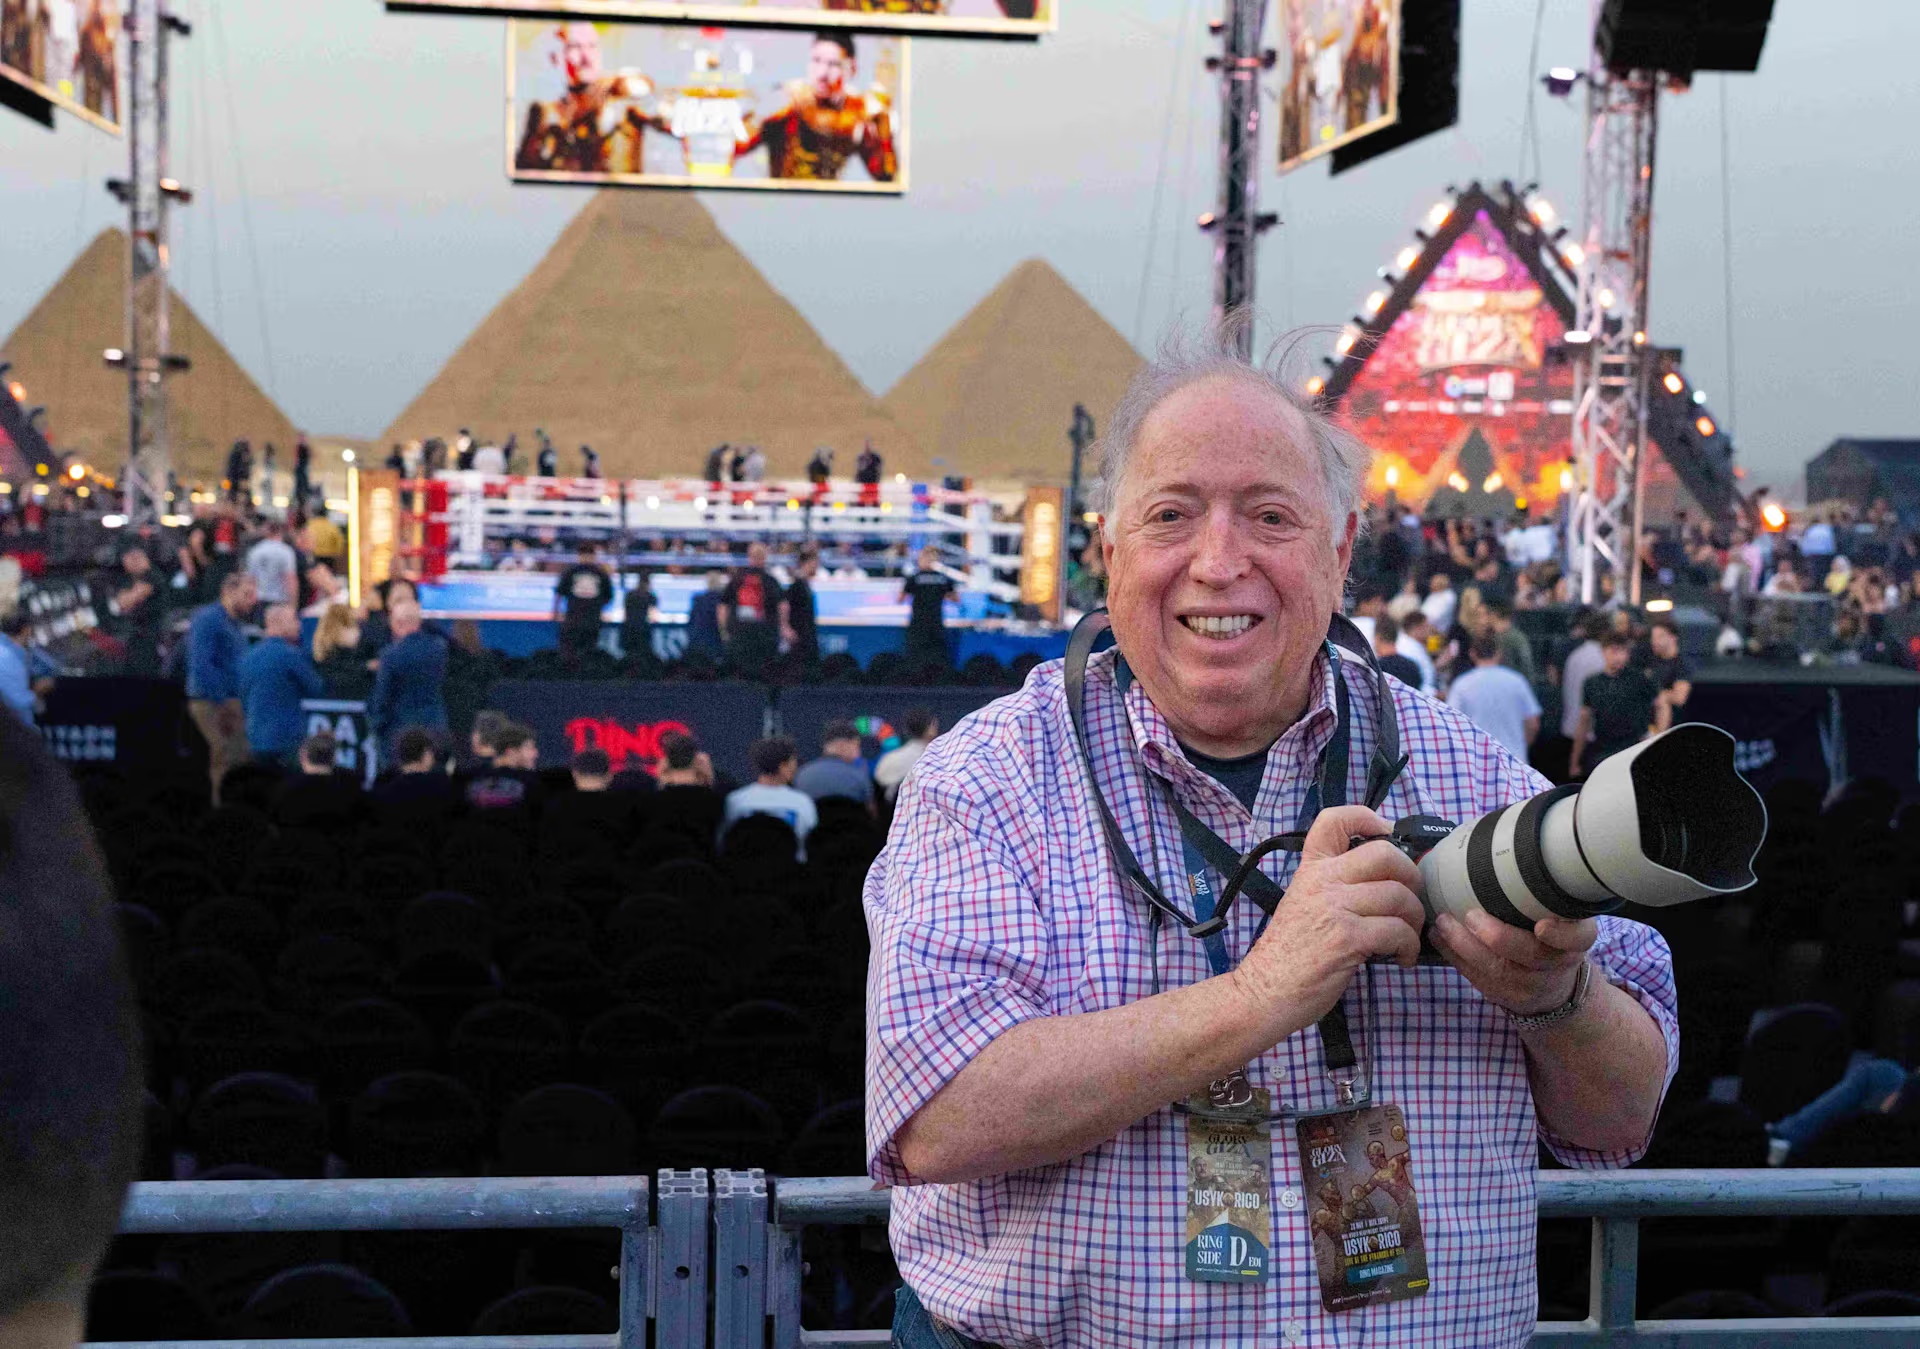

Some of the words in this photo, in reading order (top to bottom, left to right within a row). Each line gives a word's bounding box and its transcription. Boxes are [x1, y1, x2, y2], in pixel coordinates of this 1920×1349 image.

[1422, 824, 1454, 833] SONY
[1194, 1189, 1224, 1207] USYK
[1234, 1191, 1260, 1210] RICO
[1197, 1234, 1223, 1250] RING
[1343, 1235, 1372, 1257] USYK
[1377, 1230, 1401, 1250] RICO
[1197, 1250, 1222, 1265] SIDE
[1229, 1235, 1248, 1267] D
[1371, 1263, 1394, 1276] MAGAZINE
